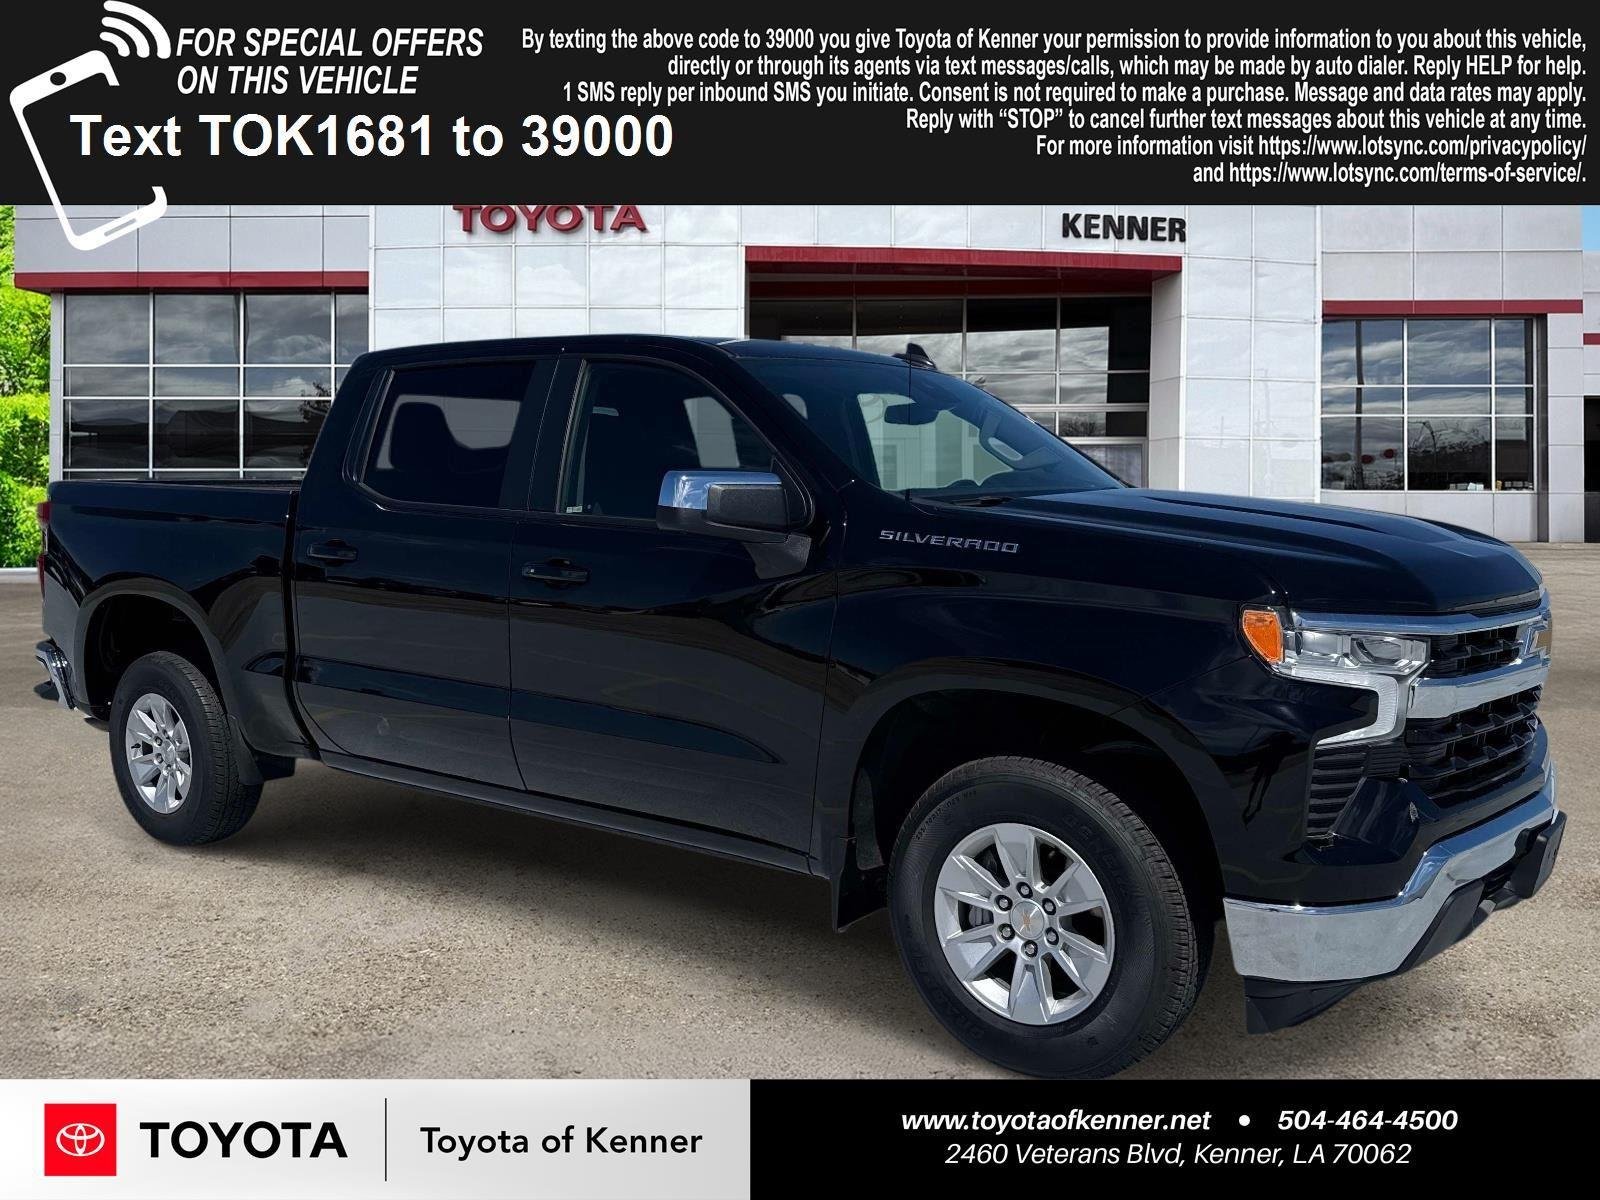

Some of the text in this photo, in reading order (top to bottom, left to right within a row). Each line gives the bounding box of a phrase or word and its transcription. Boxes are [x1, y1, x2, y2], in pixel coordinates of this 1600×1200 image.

[453, 205, 647, 232] TOYOTA
[1062, 213, 1186, 242] KENNER
[879, 529, 1020, 554] SILVERADO
